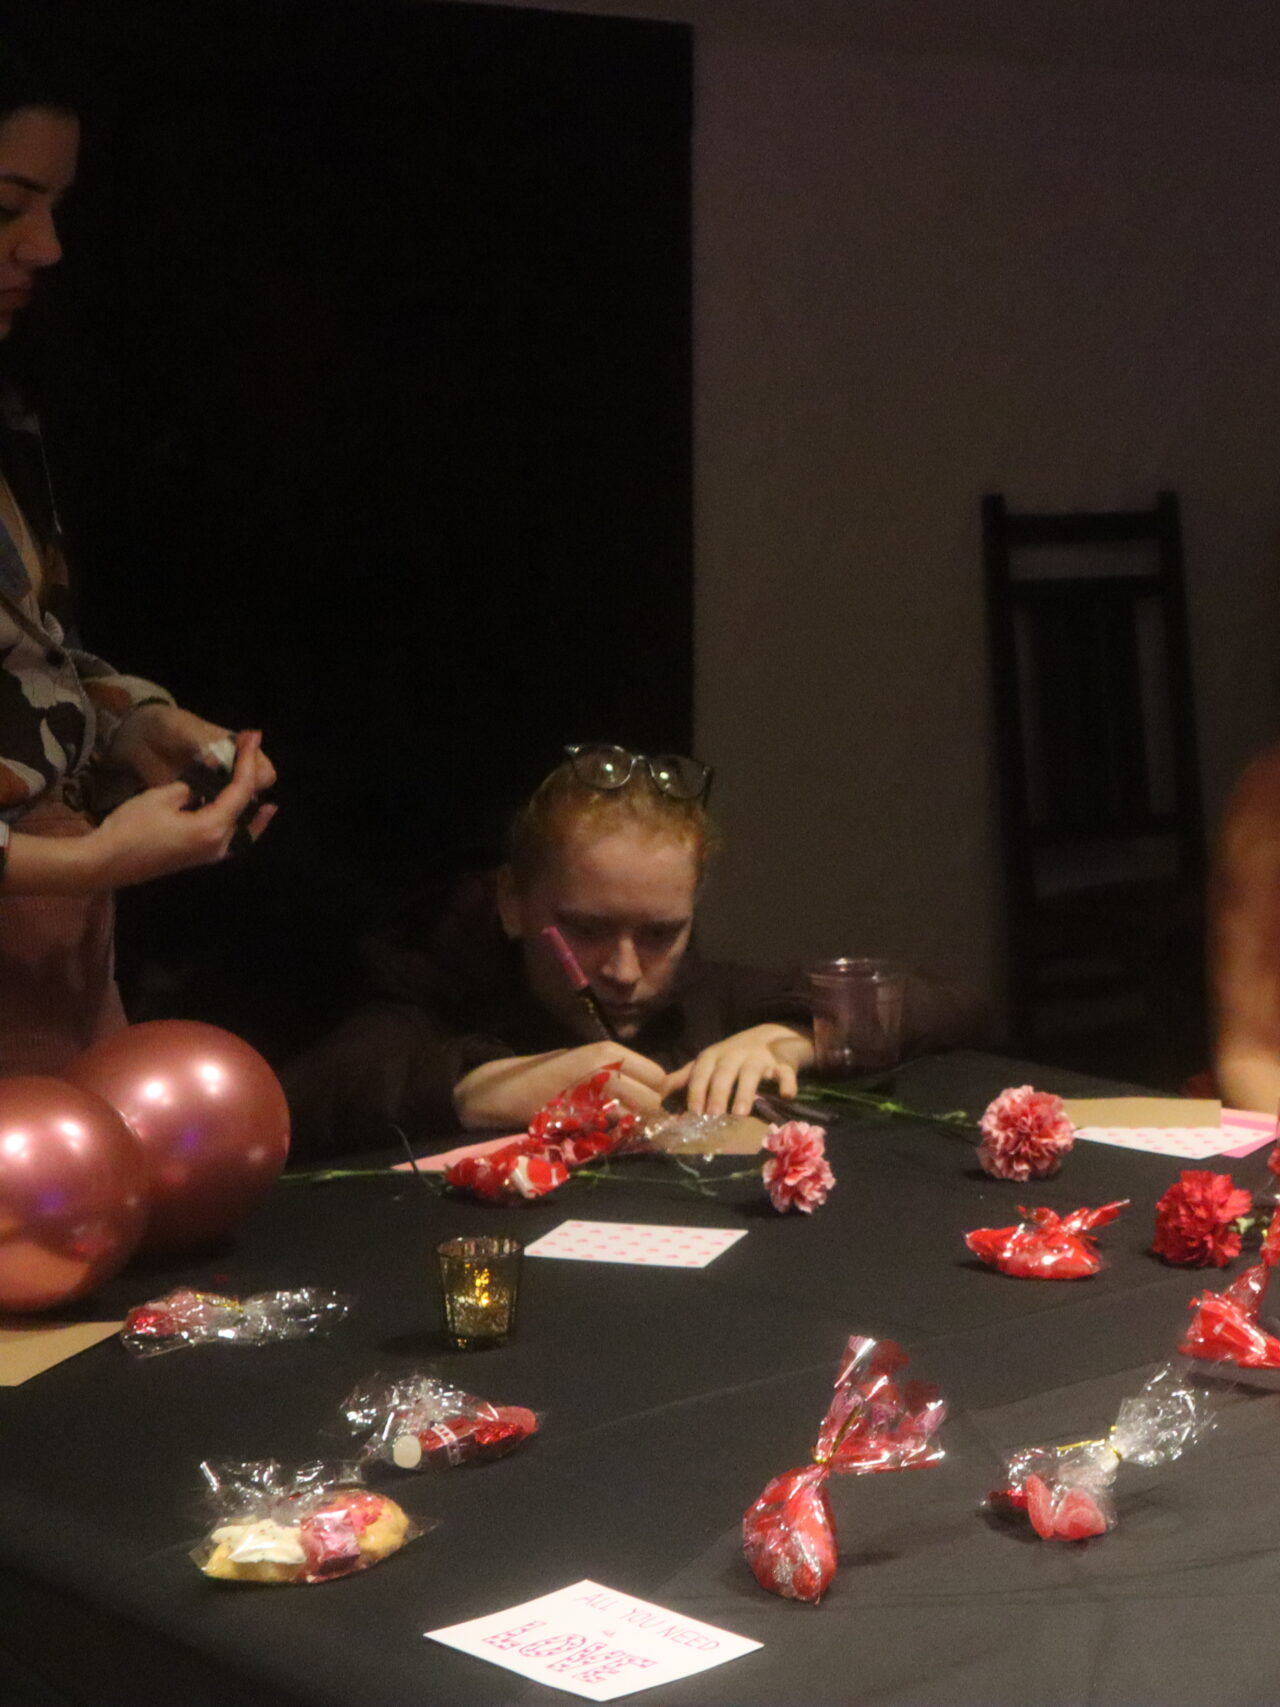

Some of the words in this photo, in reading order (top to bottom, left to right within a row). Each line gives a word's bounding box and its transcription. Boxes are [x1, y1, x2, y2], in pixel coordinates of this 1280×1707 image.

[482, 1619, 659, 1685] LOVE
[575, 1593, 618, 1612] ALL
[620, 1607, 665, 1629] YOU
[658, 1621, 721, 1652] NEED
